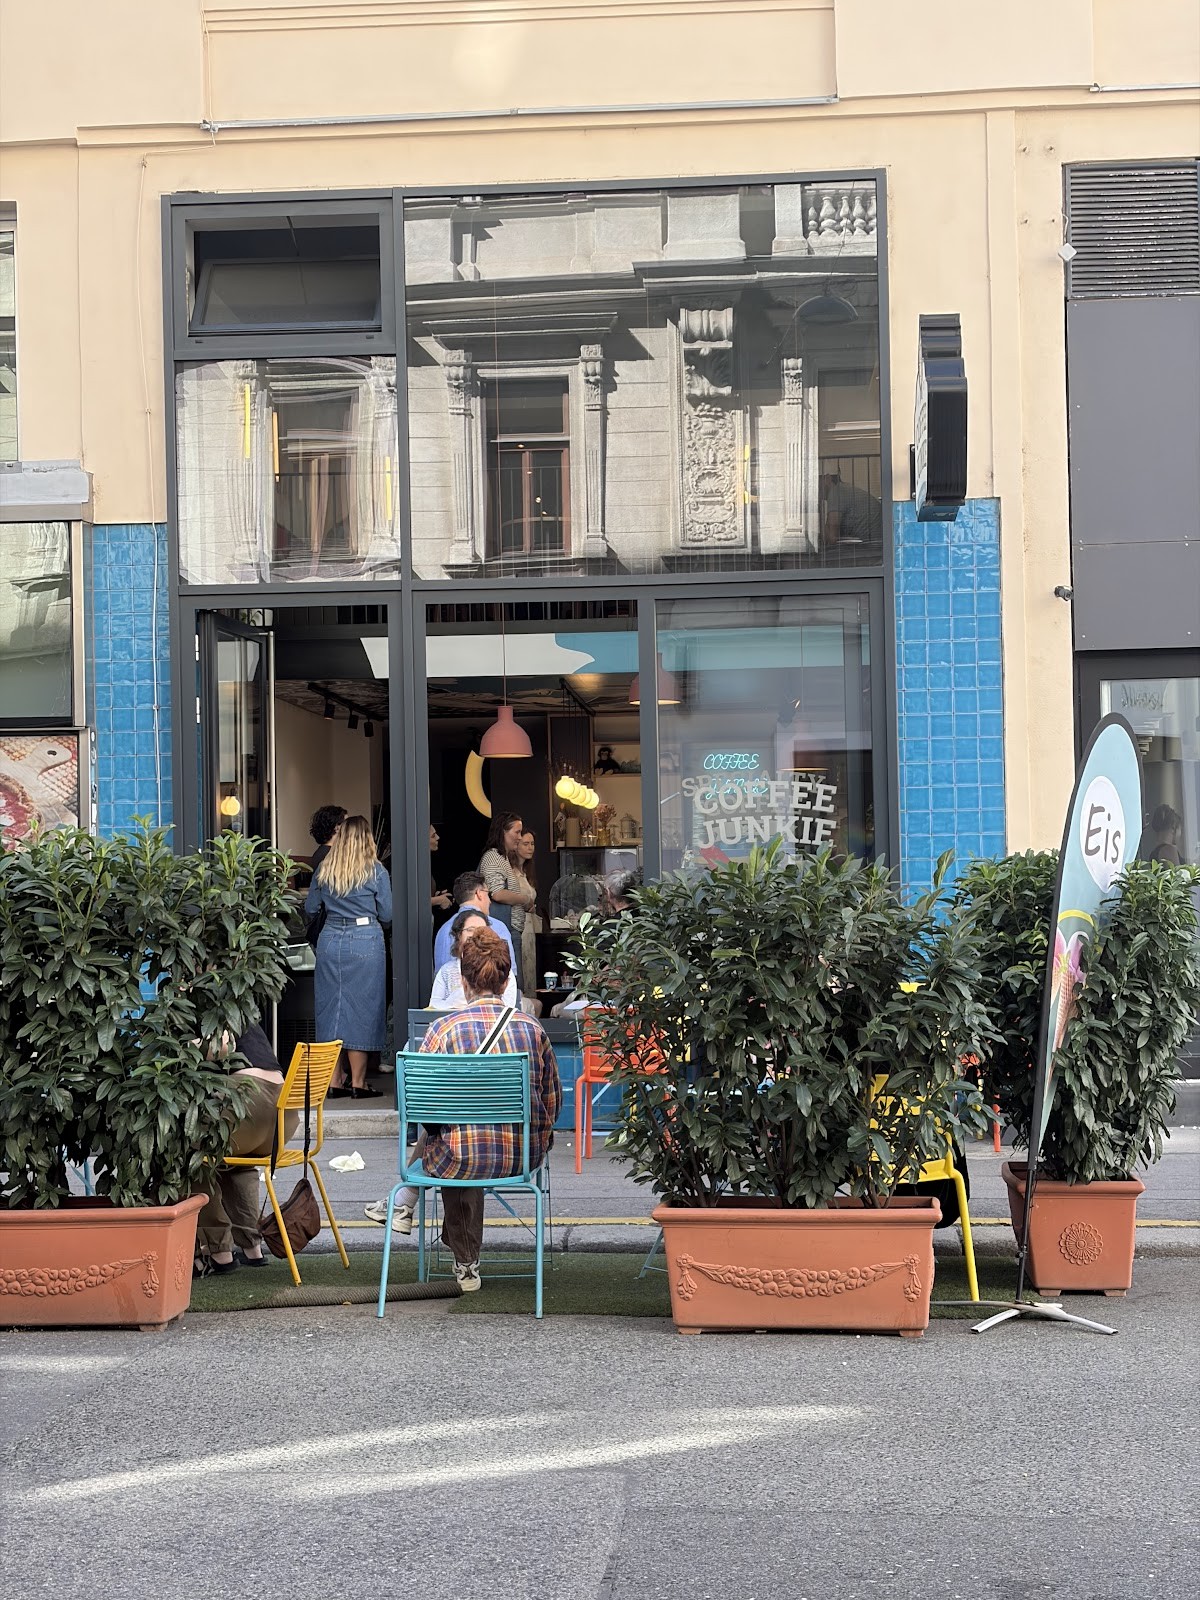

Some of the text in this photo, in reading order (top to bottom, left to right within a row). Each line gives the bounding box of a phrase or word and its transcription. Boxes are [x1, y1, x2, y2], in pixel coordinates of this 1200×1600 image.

[694, 780, 838, 814] COFFEE
[700, 815, 838, 849] JUNKIE
[1084, 803, 1121, 864] Eis
